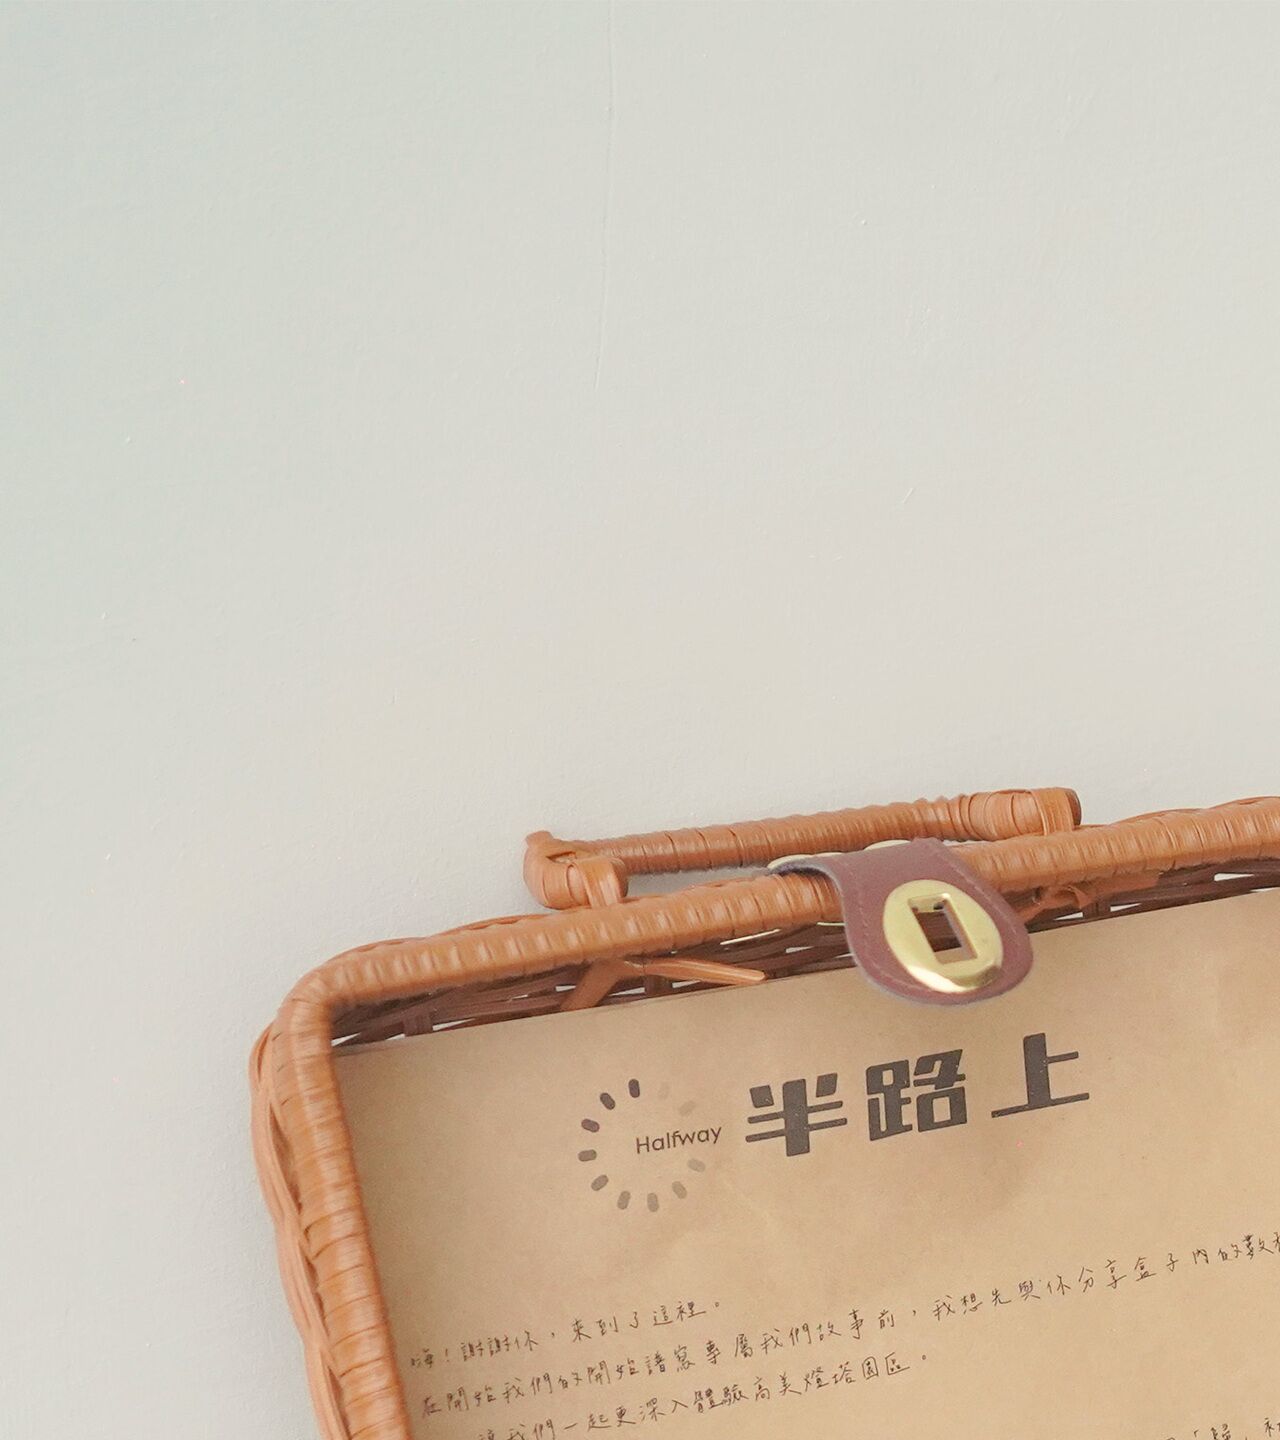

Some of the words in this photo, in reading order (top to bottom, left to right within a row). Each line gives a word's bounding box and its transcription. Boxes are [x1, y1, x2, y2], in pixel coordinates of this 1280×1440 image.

[745, 1033, 1090, 1157] 半路上
[635, 1124, 723, 1155] Halfway
